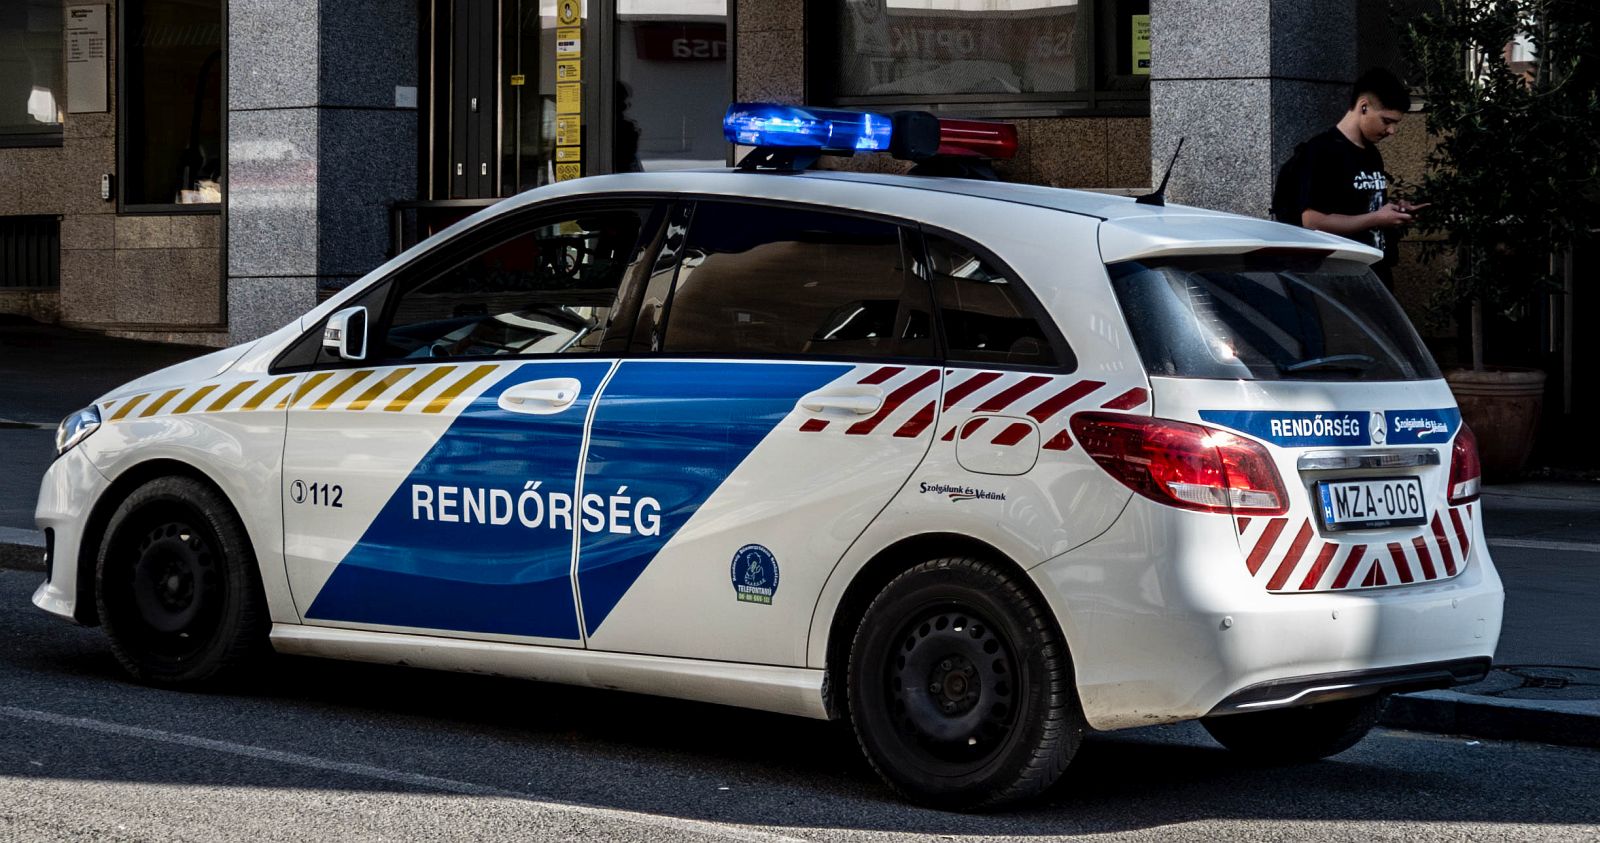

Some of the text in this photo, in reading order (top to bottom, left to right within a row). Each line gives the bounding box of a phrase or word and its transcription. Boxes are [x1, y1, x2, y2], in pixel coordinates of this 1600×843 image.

[1270, 414, 1360, 437] RENDŐRSÉG
[308, 481, 344, 509] 112
[919, 481, 1007, 501] Szolgálunk és Védünk
[1325, 483, 1418, 518] H MZA-006
[412, 480, 661, 536] RENDŐRSÉG
